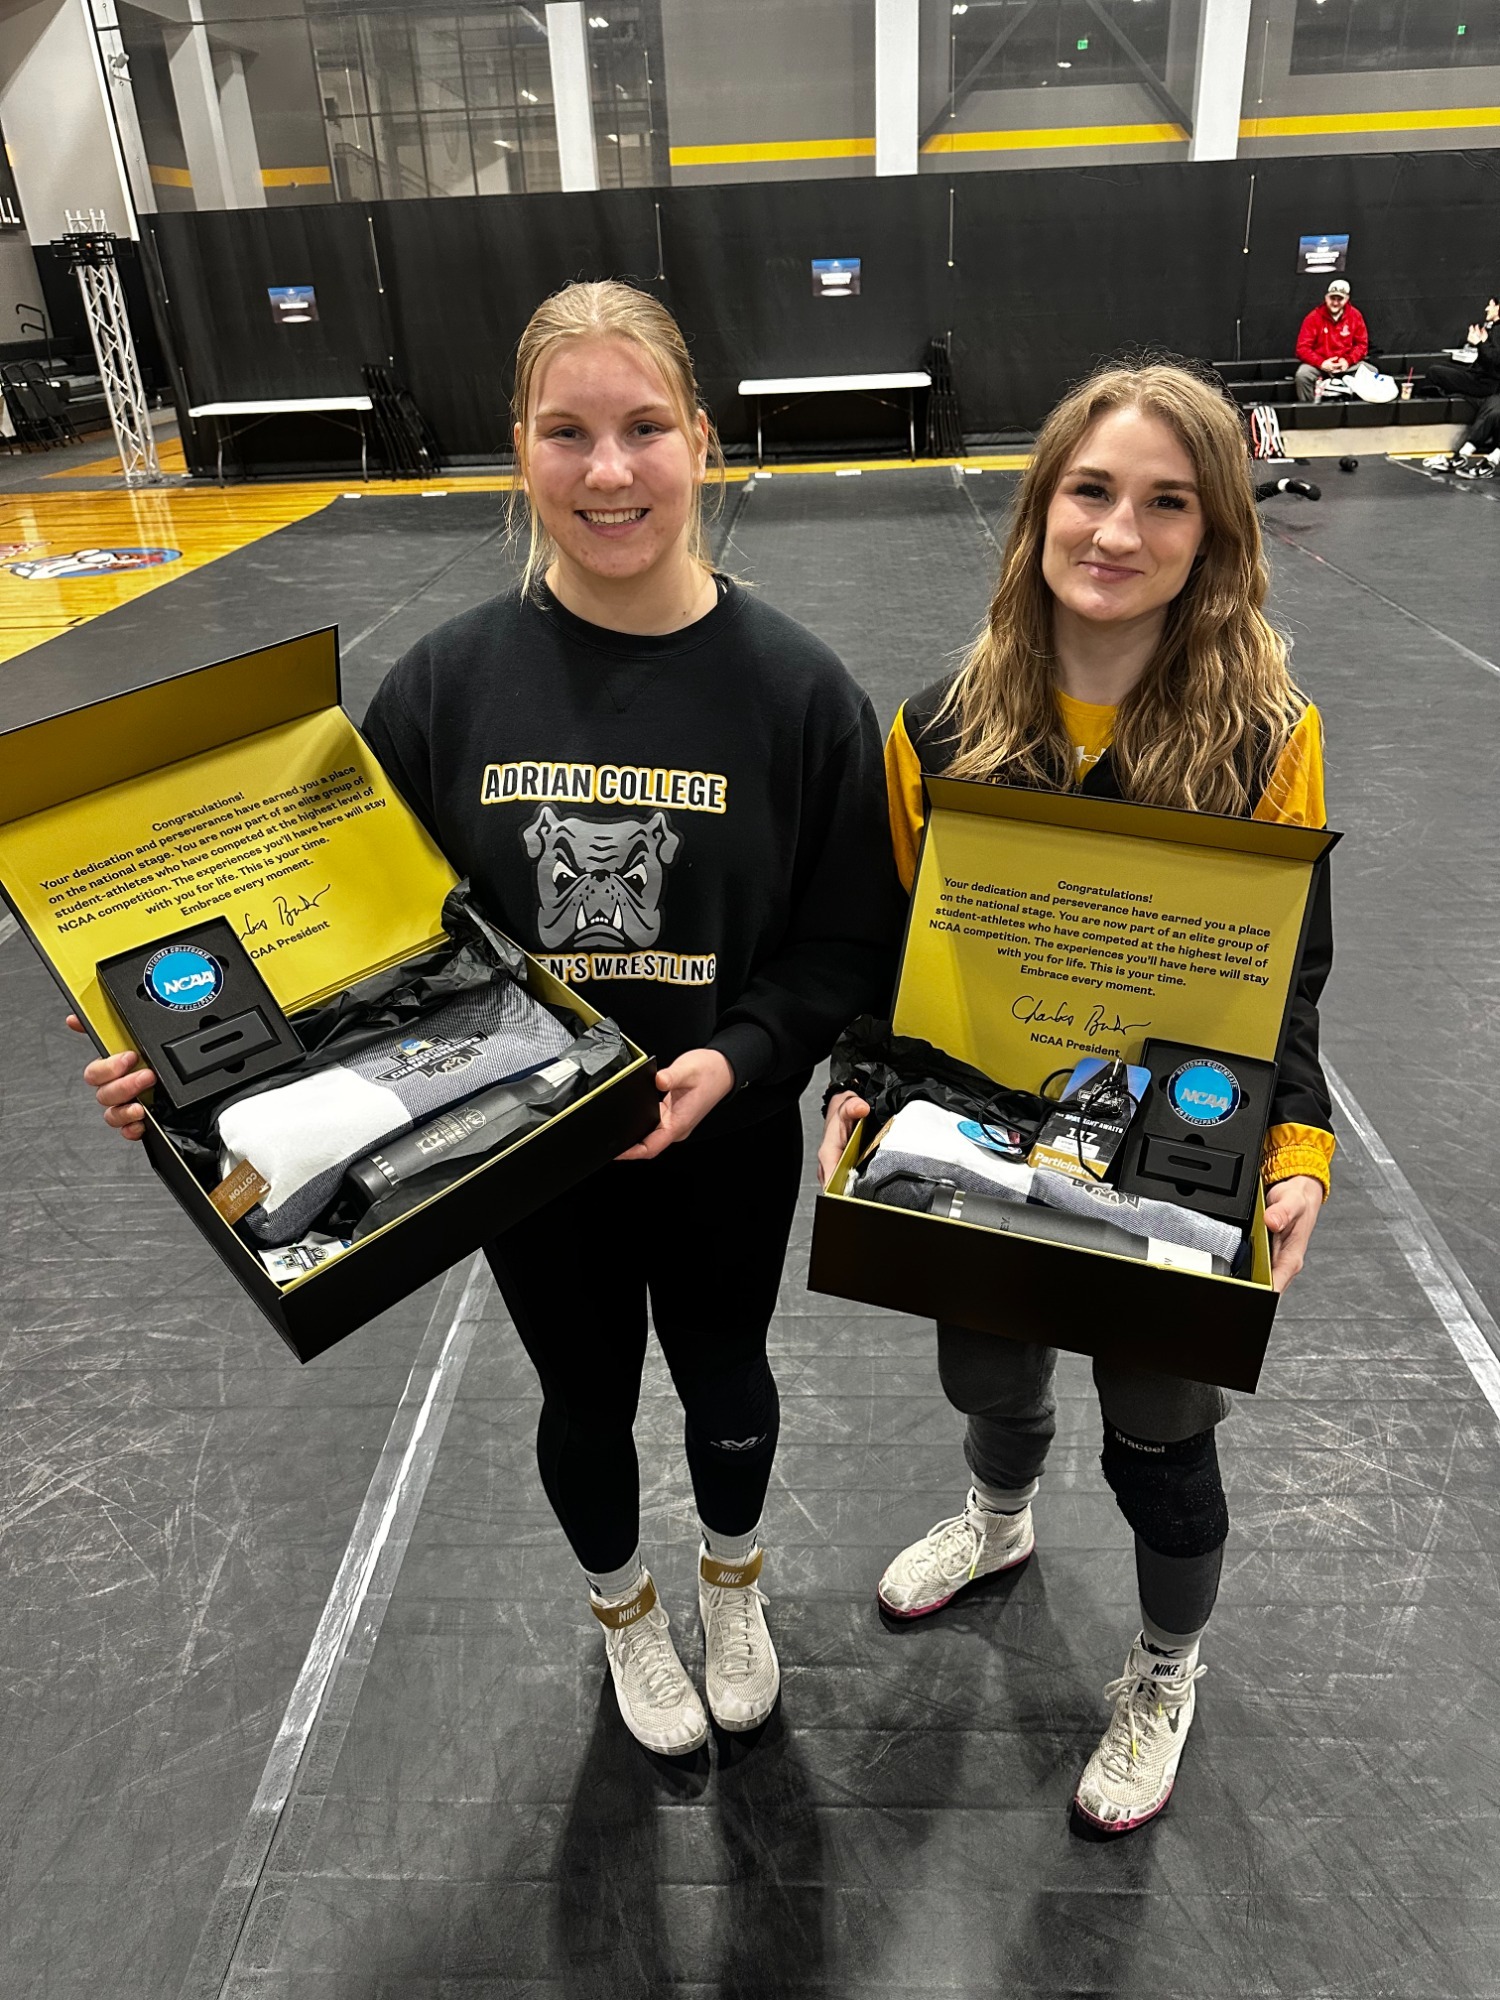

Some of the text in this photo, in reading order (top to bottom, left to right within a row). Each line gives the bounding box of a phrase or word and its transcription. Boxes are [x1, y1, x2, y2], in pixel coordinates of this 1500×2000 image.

[483, 764, 725, 812] ADRIAN COLLEGE
[39, 874, 71, 890] Your
[71, 850, 135, 879] dedication
[134, 839, 158, 855] and
[157, 812, 234, 848] perseverance
[233, 802, 262, 817] have
[261, 785, 300, 806] earned
[299, 780, 319, 794] you
[328, 766, 356, 783] place
[151, 791, 245, 832] Congratulations!
[48, 775, 365, 905] on the national stage. You are now part of an elite group of
[54, 786, 375, 919] student-athletes who have competed at the highest level of
[57, 798, 387, 934] NCAA competition. The experiences you'll have here will stay
[144, 837, 330, 915] with you for life. This is your time.
[179, 858, 315, 917] Embrace every moment.
[944, 876, 1271, 938] Your dedication and perseverance have earned you a place
[1057, 880, 1154, 904] Congratulations!
[249, 920, 330, 959] CAA President
[935, 907, 1269, 969] student-athletes who have competed at the highest level of
[939, 893, 1270, 953] on the national stage. You are now part of an elite group of
[592, 953, 715, 983] WRESTLING
[929, 919, 1270, 987] NCAA competition. The experiences you'll have here will stay
[997, 946, 1187, 986] with you for life. This is your time.
[163, 970, 216, 996] NCAA
[1020, 964, 1156, 997] Embrace every moment.
[1030, 1032, 1120, 1058] NCAA President
[1180, 1087, 1229, 1111] NCAA
[1034, 1152, 1090, 1176] Participan
[226, 1171, 258, 1202] COTTON
[716, 1570, 745, 1584] NIKE
[618, 1600, 642, 1623] NIKE
[1150, 1662, 1181, 1677] NIKE
